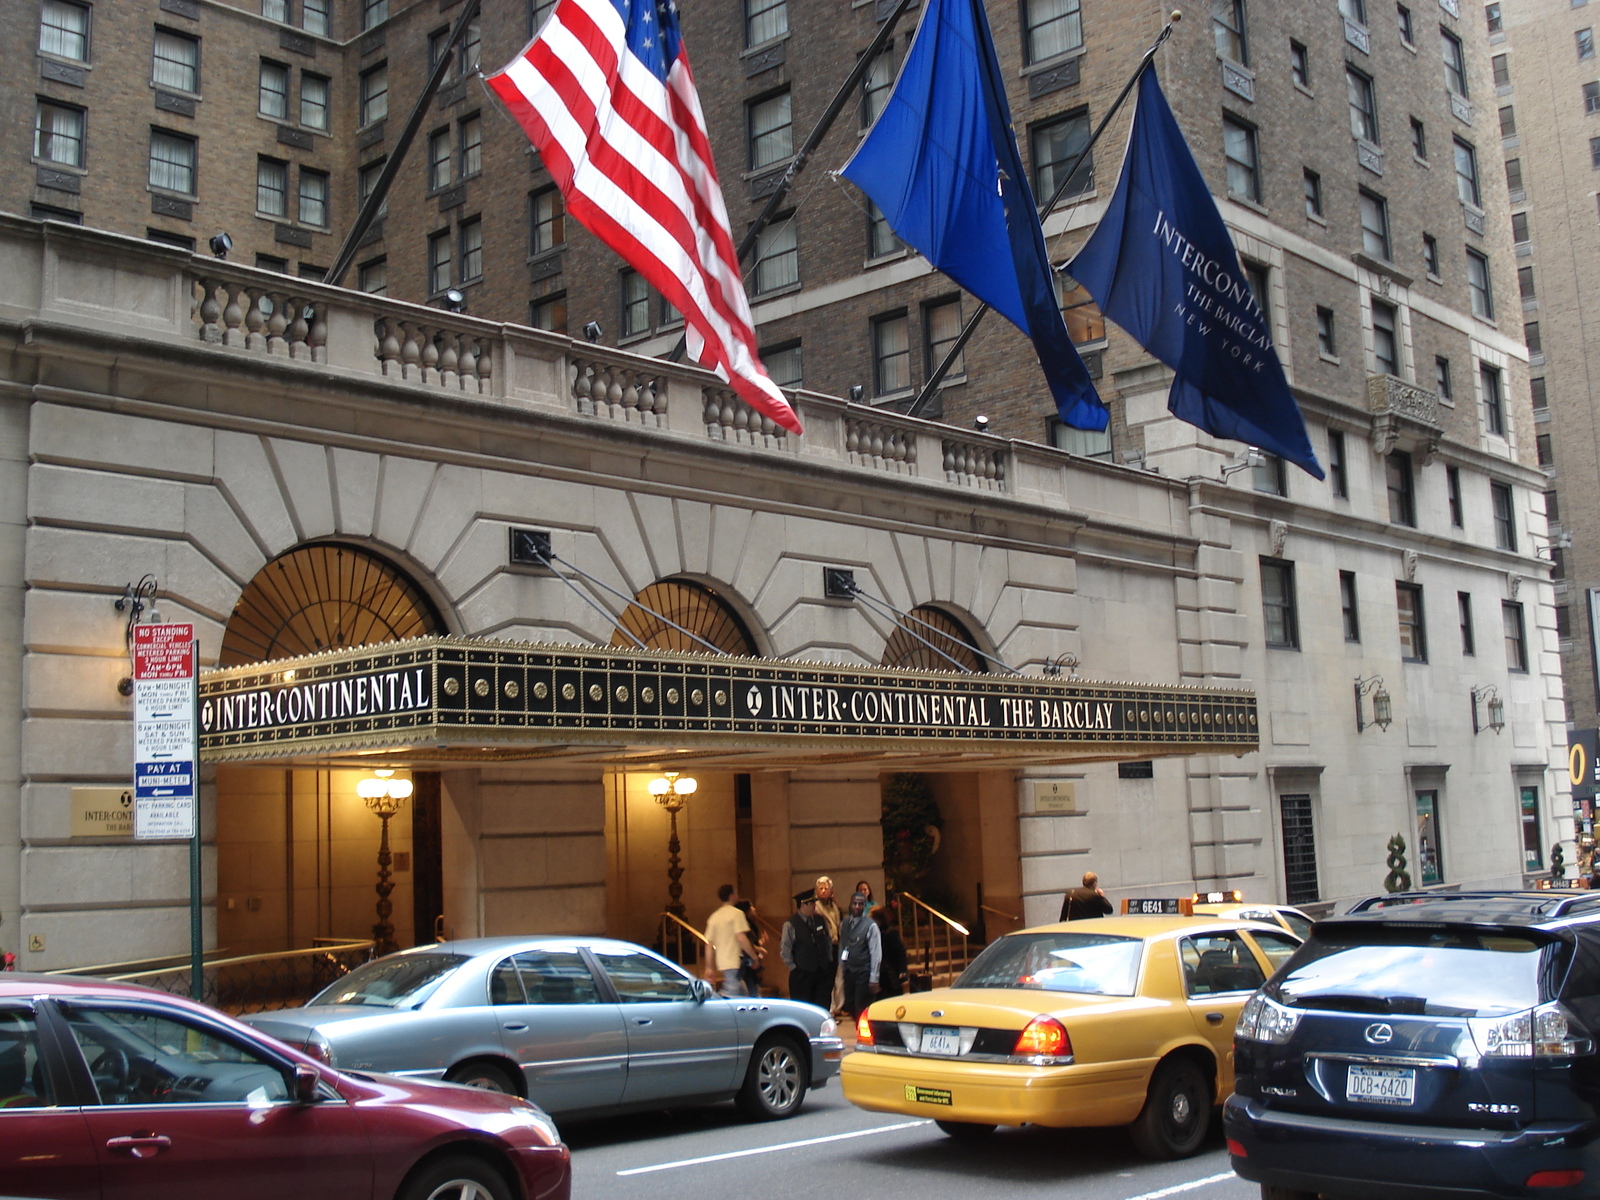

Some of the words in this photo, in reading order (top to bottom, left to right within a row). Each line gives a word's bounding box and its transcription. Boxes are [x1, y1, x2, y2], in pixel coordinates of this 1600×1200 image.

[1153, 211, 1264, 323] INTERCONTI
[1187, 282, 1213, 312] THE
[1215, 306, 1274, 351] BARCLAY
[1174, 303, 1211, 336] NEW
[1221, 338, 1265, 373] YORK
[139, 628, 150, 637] NO
[152, 626, 189, 637] STANDING
[165, 648, 190, 656] PARKING
[146, 663, 182, 671] 7AM-6PM
[1000, 698, 1035, 727] THE
[1040, 699, 1114, 730] BARCLAY
[147, 764, 165, 774] PAY
[169, 764, 181, 773] AT
[141, 776, 187, 785] MUNI-METER
[106, 823, 117, 831] THE
[1142, 900, 1163, 913] 6E41
